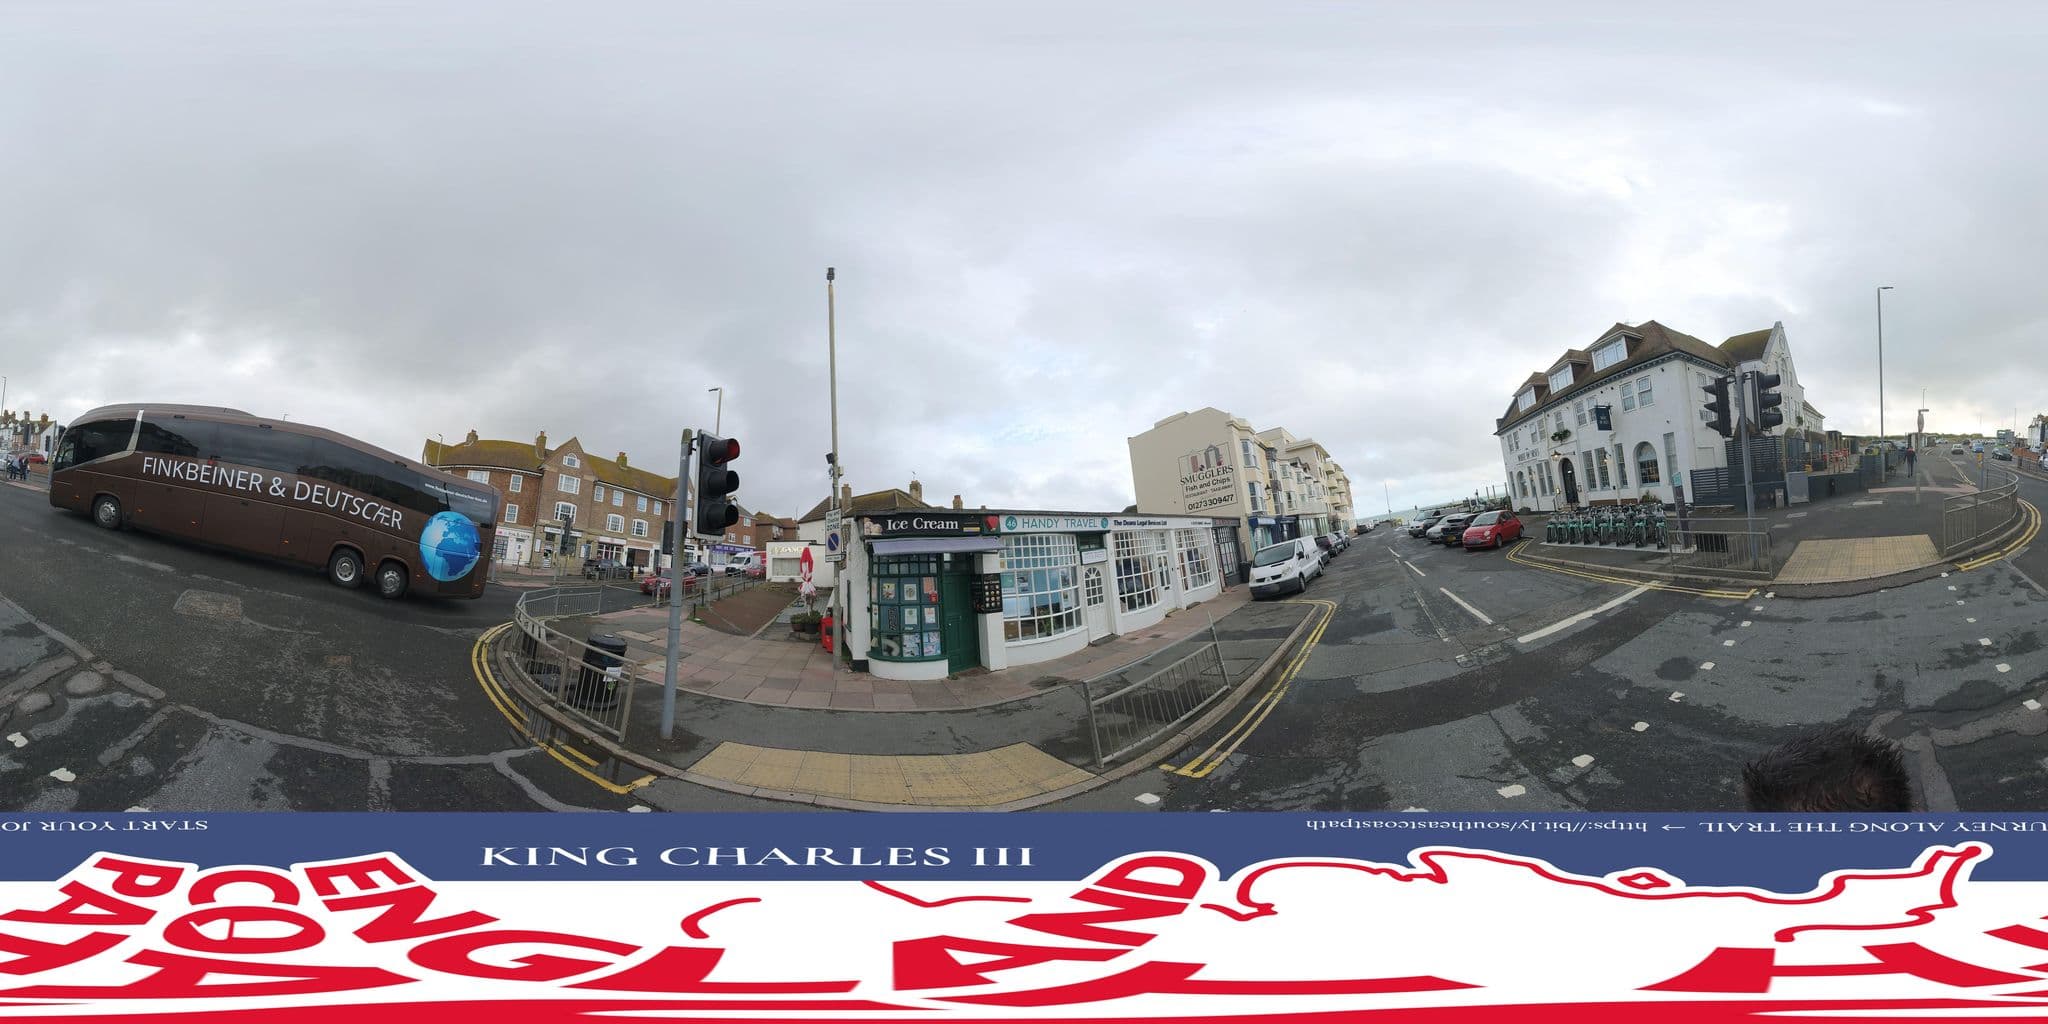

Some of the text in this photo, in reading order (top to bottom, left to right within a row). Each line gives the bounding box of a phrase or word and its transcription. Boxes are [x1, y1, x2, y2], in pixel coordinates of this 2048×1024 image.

[142, 456, 263, 493] FINKBEINER
[269, 476, 286, 498] &
[1180, 465, 1234, 485] SMUGGLERS
[1199, 481, 1211, 489] and
[1211, 477, 1231, 485] Chips
[886, 517, 959, 530] Ice Cream
[1022, 518, 1059, 528] HANDY
[1064, 518, 1098, 528] TRAVEL
